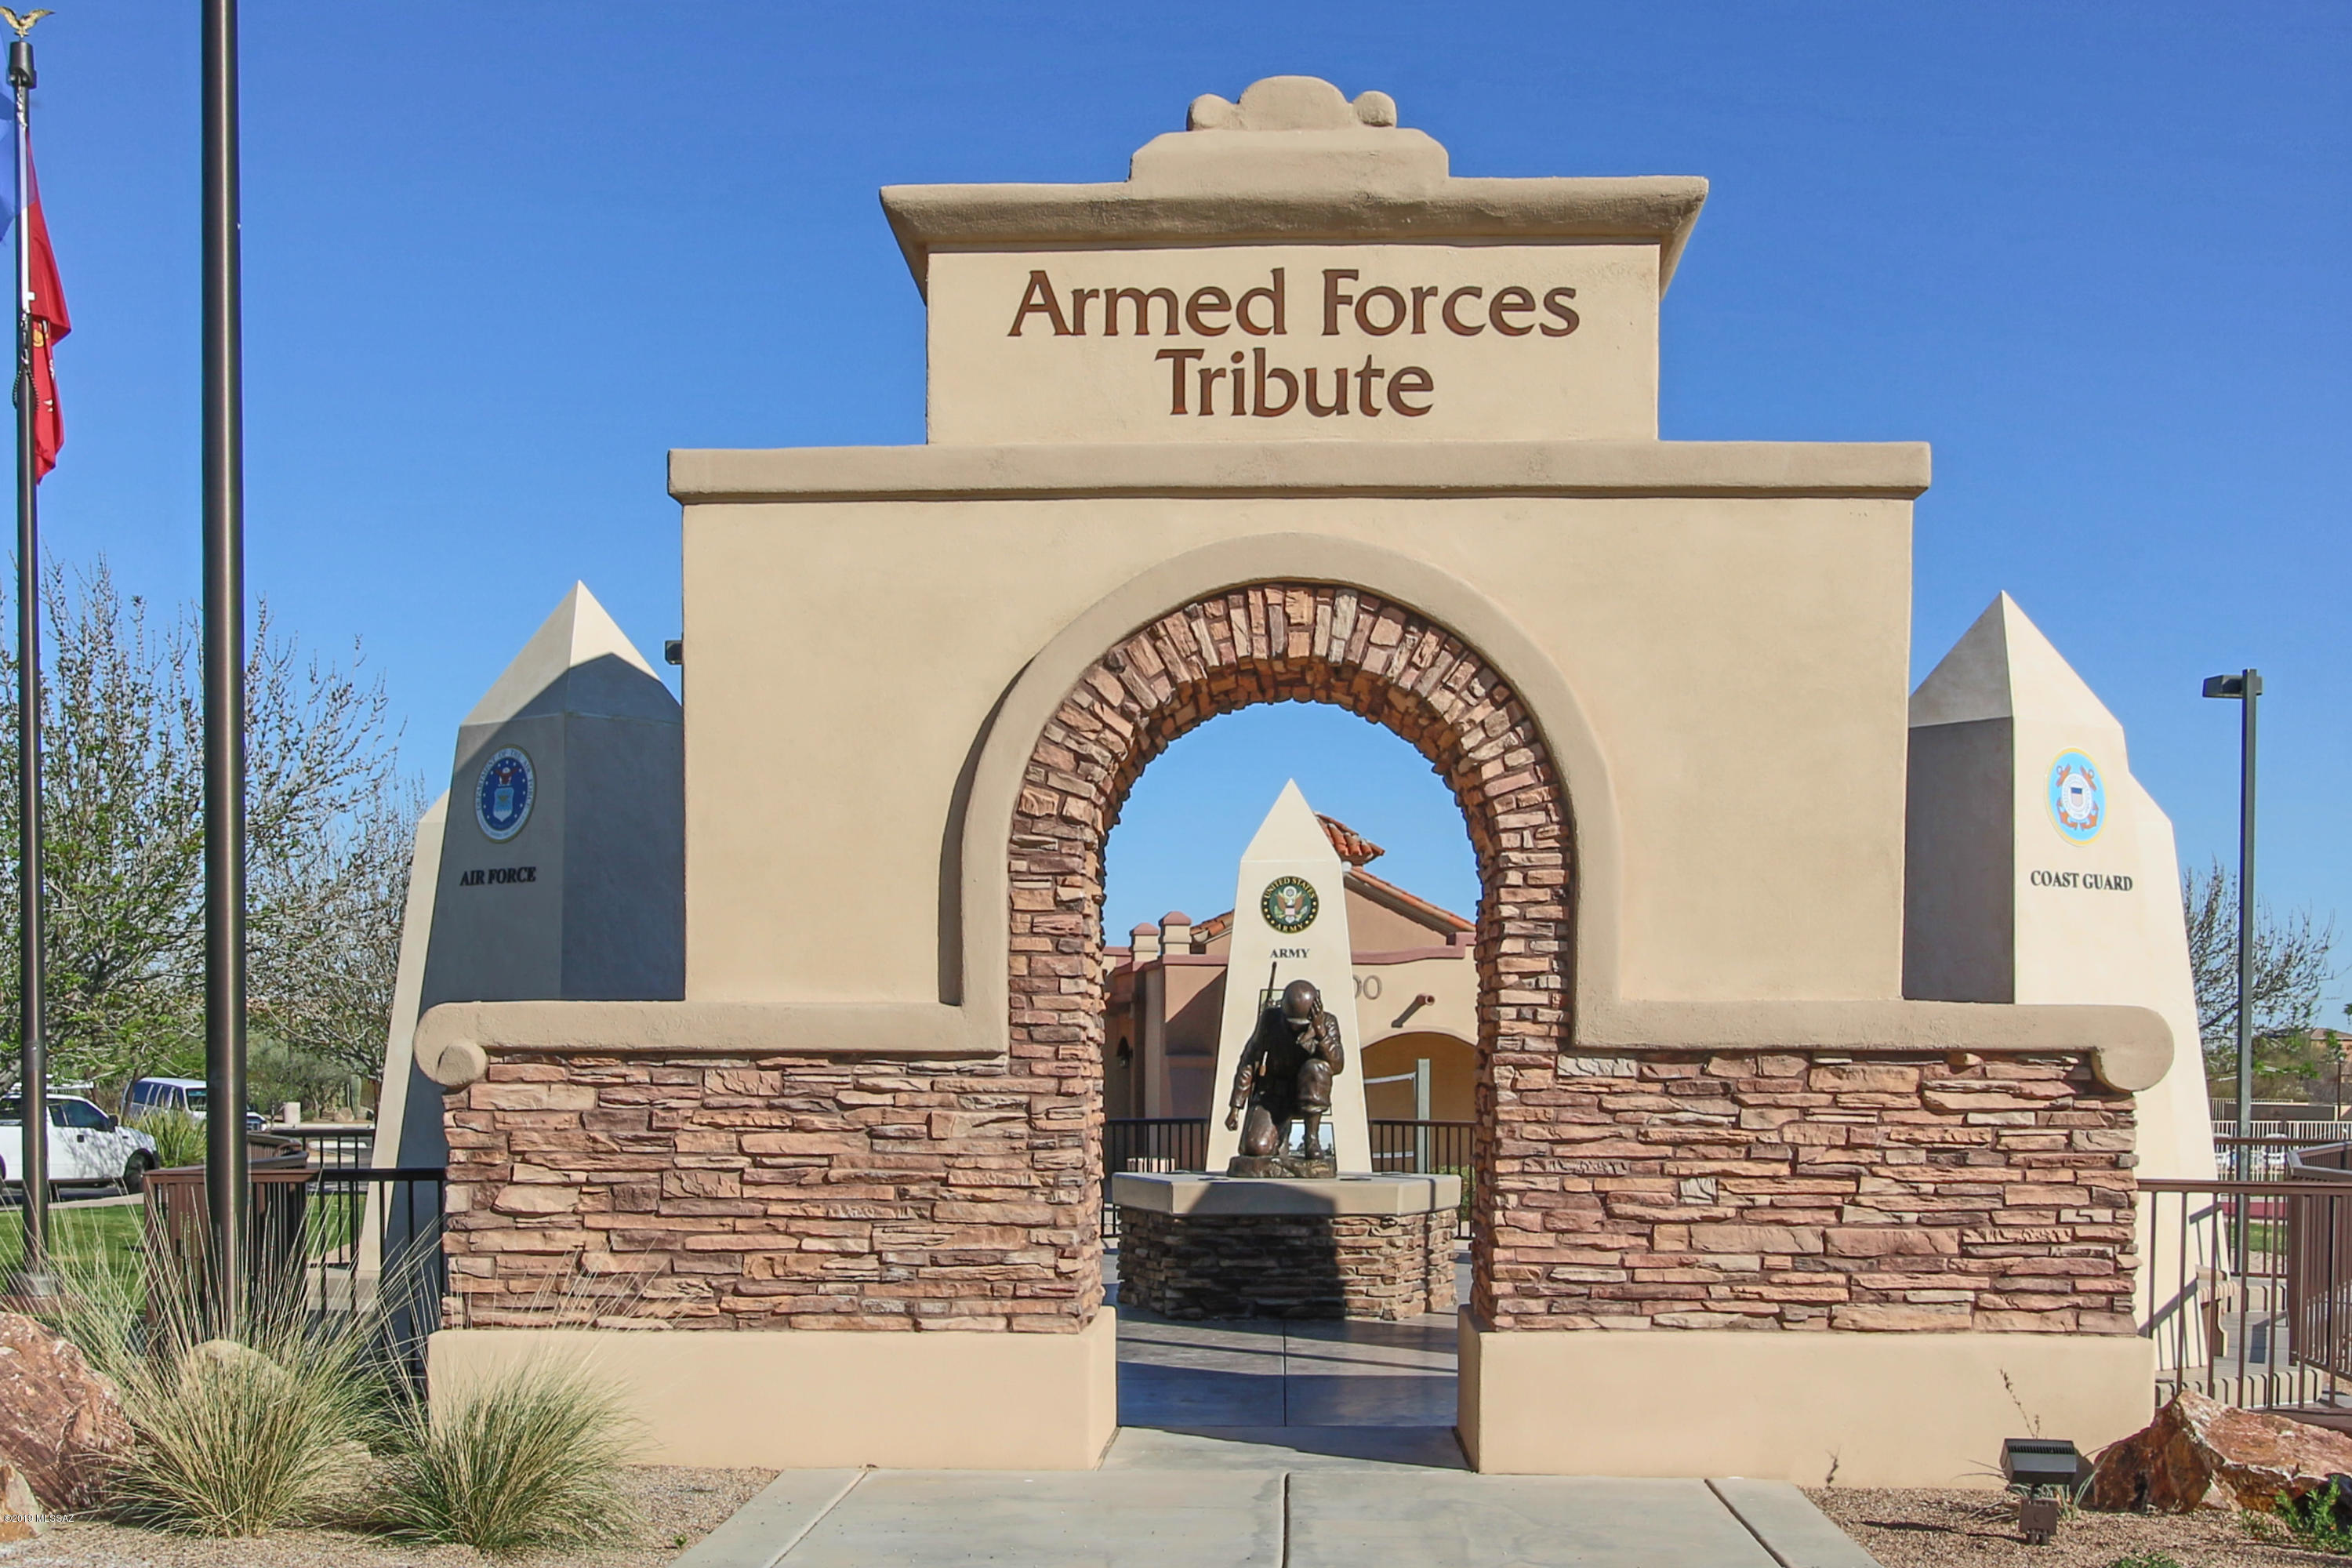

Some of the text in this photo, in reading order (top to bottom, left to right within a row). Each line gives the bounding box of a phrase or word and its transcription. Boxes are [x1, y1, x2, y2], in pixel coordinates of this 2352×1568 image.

[1007, 267, 1580, 337] Armed Forces
[1155, 347, 1434, 417] Tribute
[459, 866, 536, 887] AIR FORCE
[2031, 870, 2132, 891] COAST GUARD
[1264, 877, 1316, 899] UNITED STATES
[1276, 923, 1304, 932] ARMY
[1270, 948, 1310, 958] ARMY
